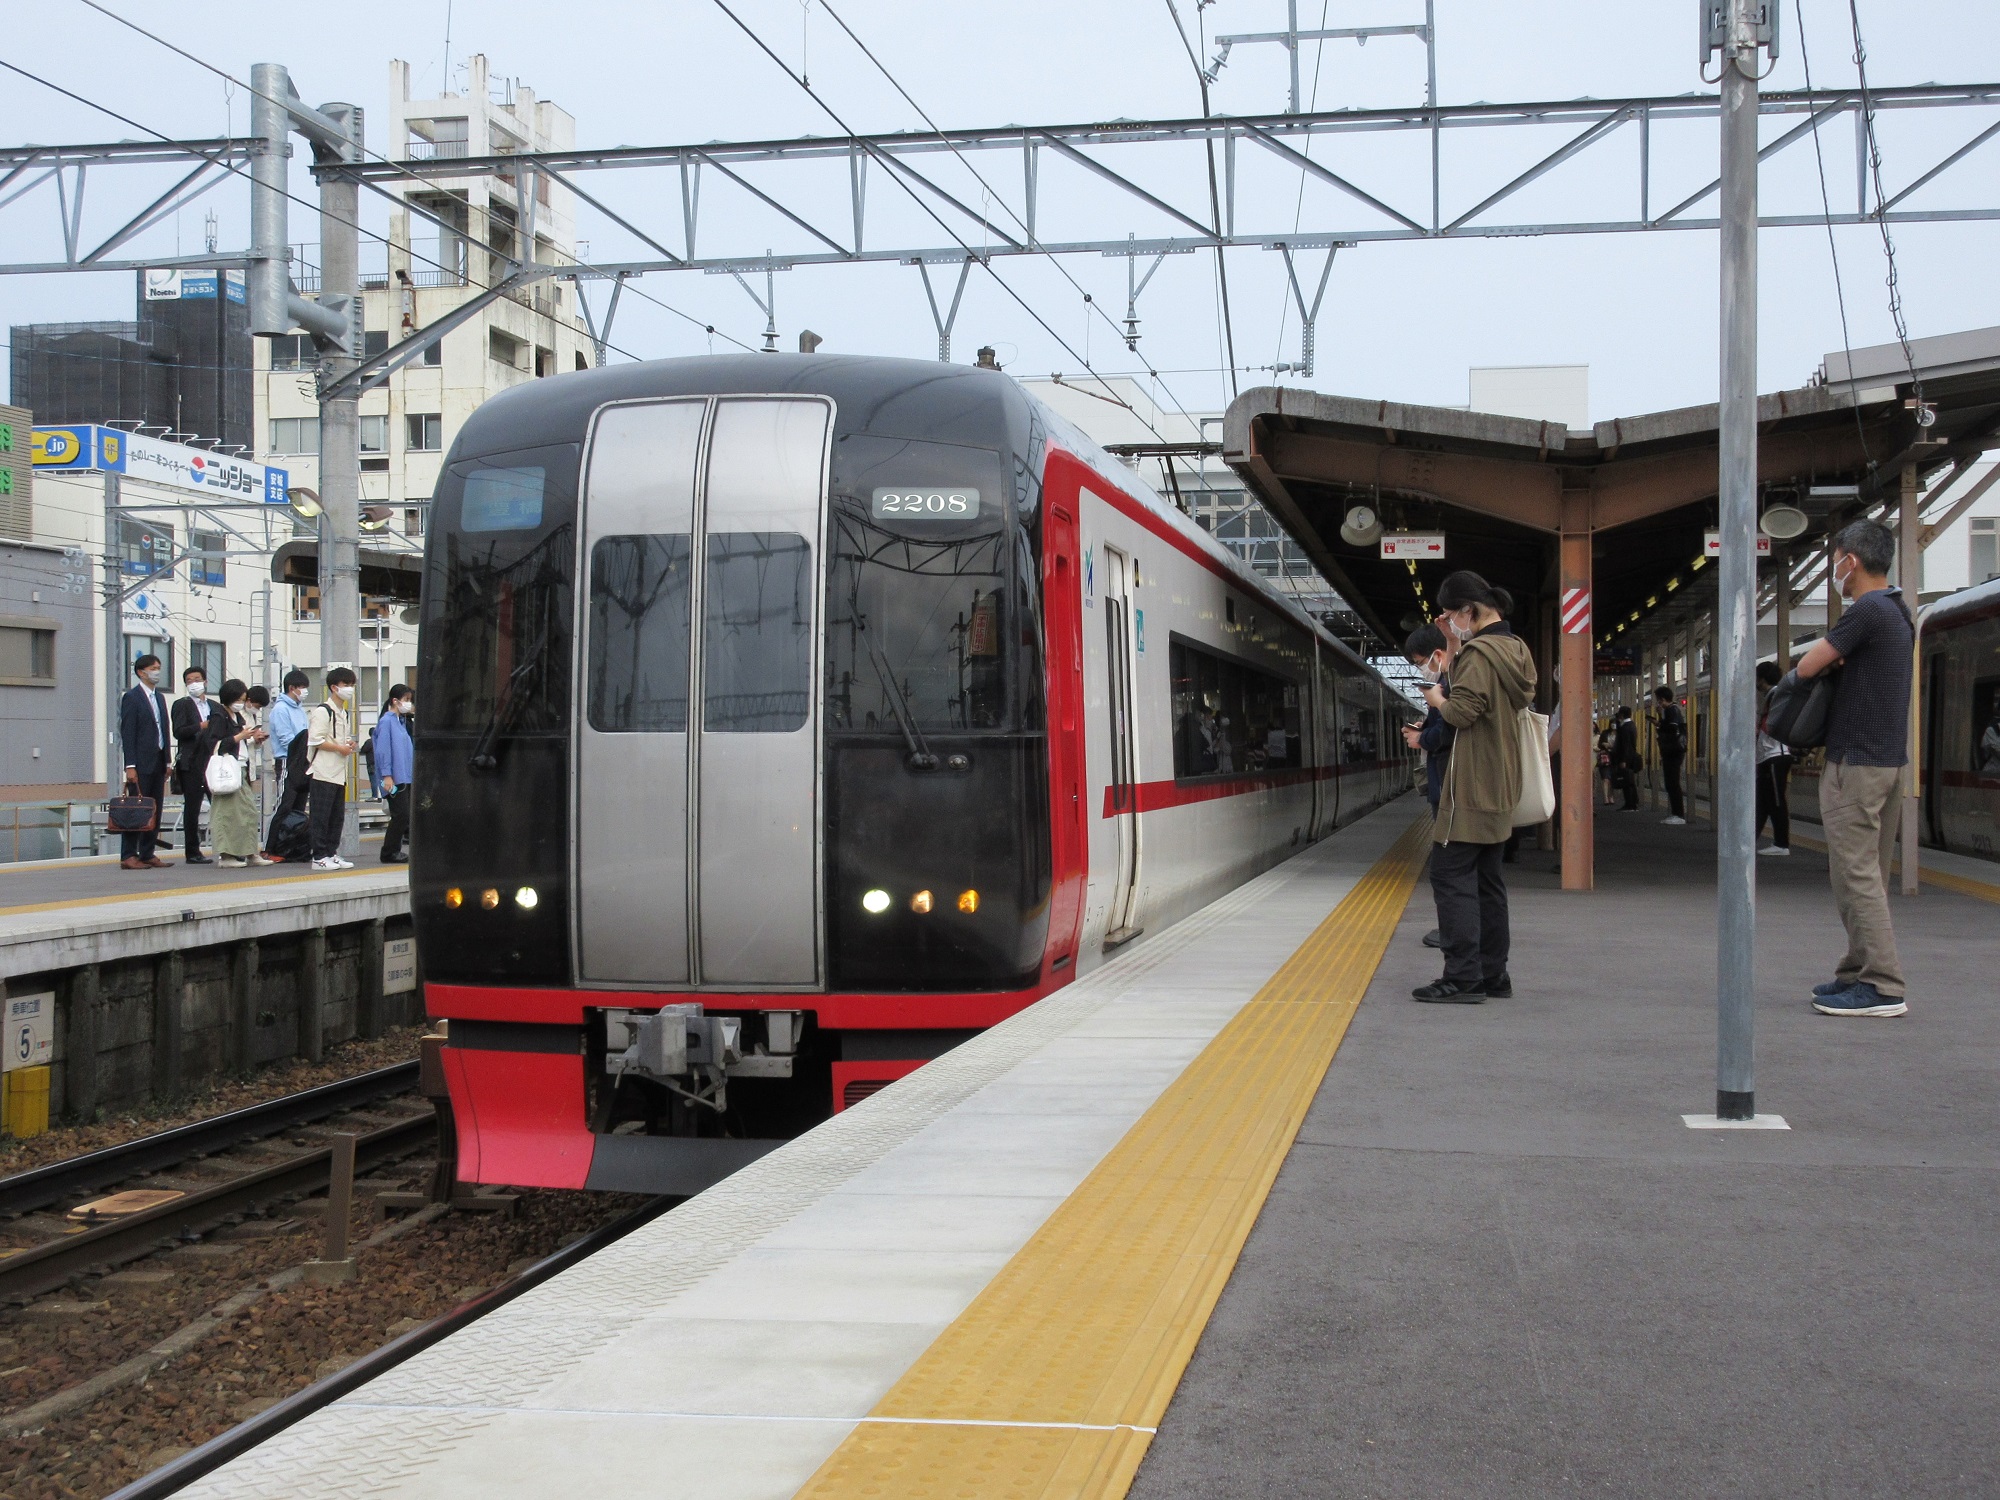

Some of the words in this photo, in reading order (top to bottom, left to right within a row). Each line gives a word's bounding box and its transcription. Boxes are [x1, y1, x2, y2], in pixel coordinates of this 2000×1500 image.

[207, 460, 263, 493] ニッショー
[882, 494, 967, 513] 2208
[12, 999, 40, 1016] 乗車位置
[20, 1028, 30, 1059] 5
